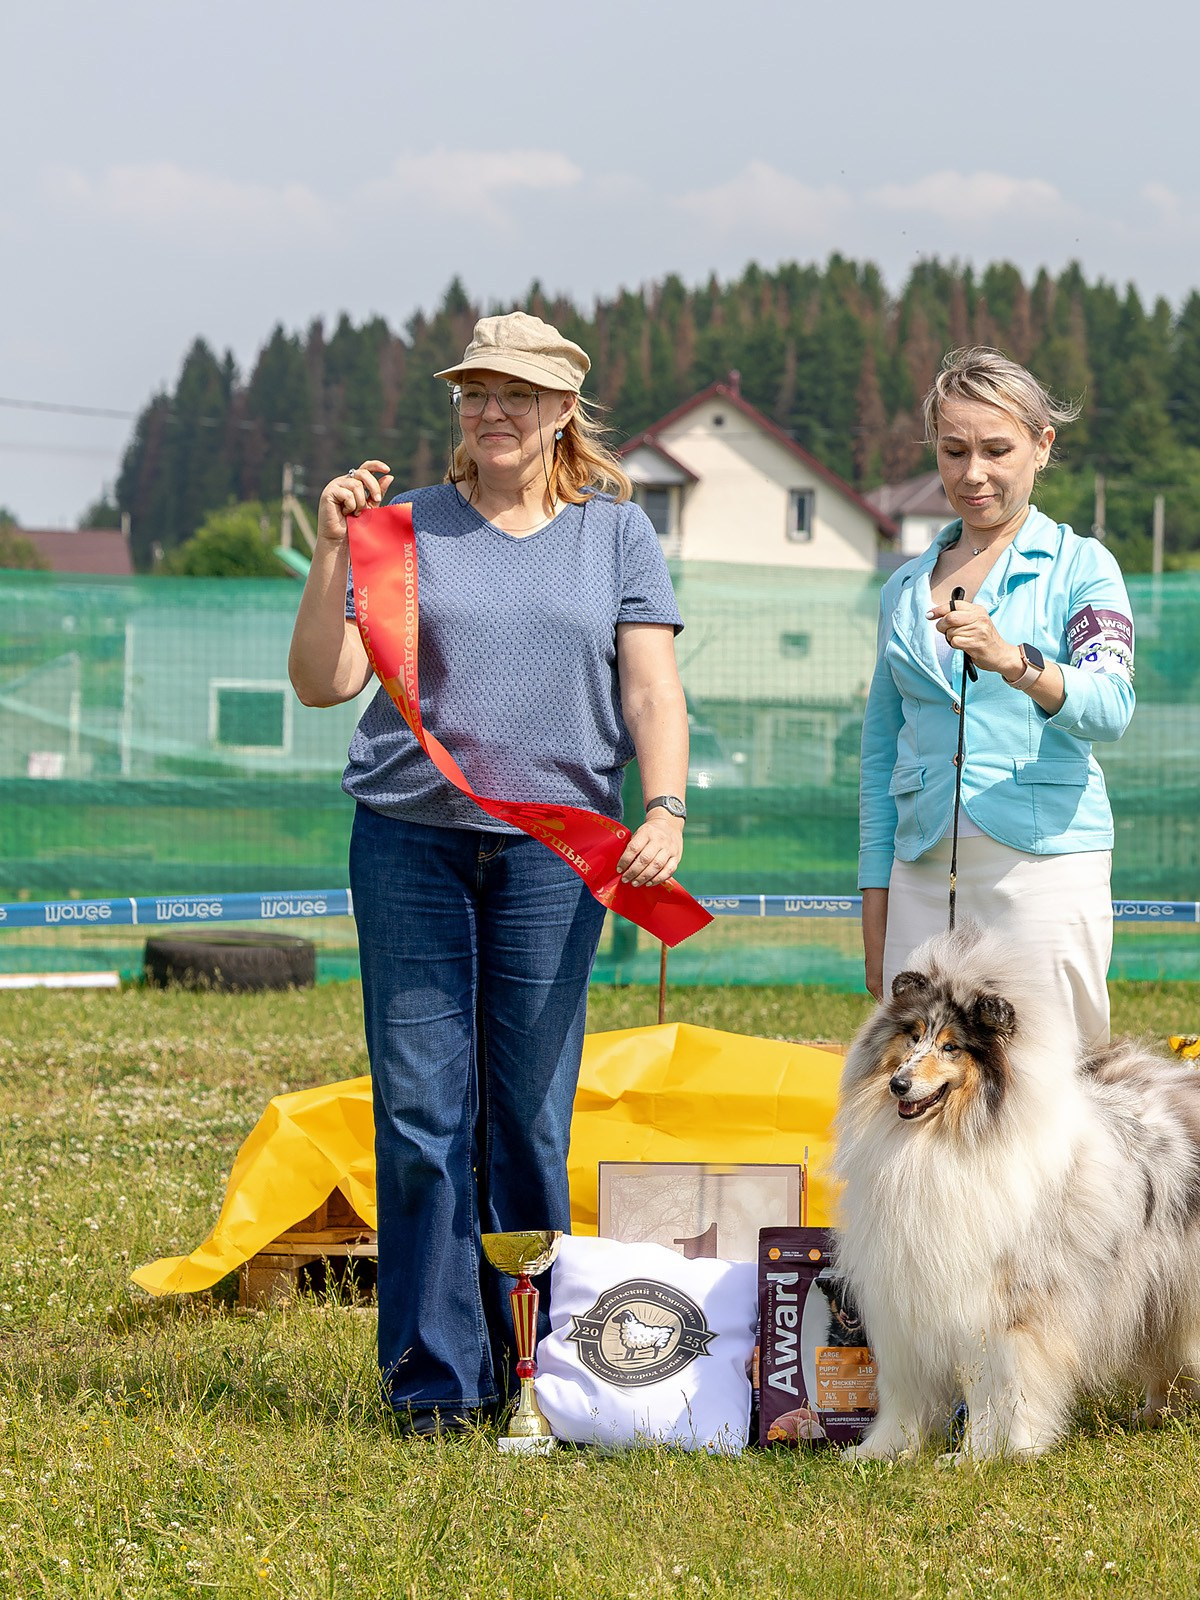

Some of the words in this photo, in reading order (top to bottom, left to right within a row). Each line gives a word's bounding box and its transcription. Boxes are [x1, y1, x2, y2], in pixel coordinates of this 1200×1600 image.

[358, 585, 380, 673] УРАЛЬСК
[402, 542, 417, 701] МОНОПОРОДНАЯ
[1096, 617, 1131, 637] Award
[512, 814, 592, 875] СТУШЬИХ
[581, 1326, 599, 1337] 20
[684, 1335, 701, 1349] 25
[766, 1272, 799, 1396] Award
